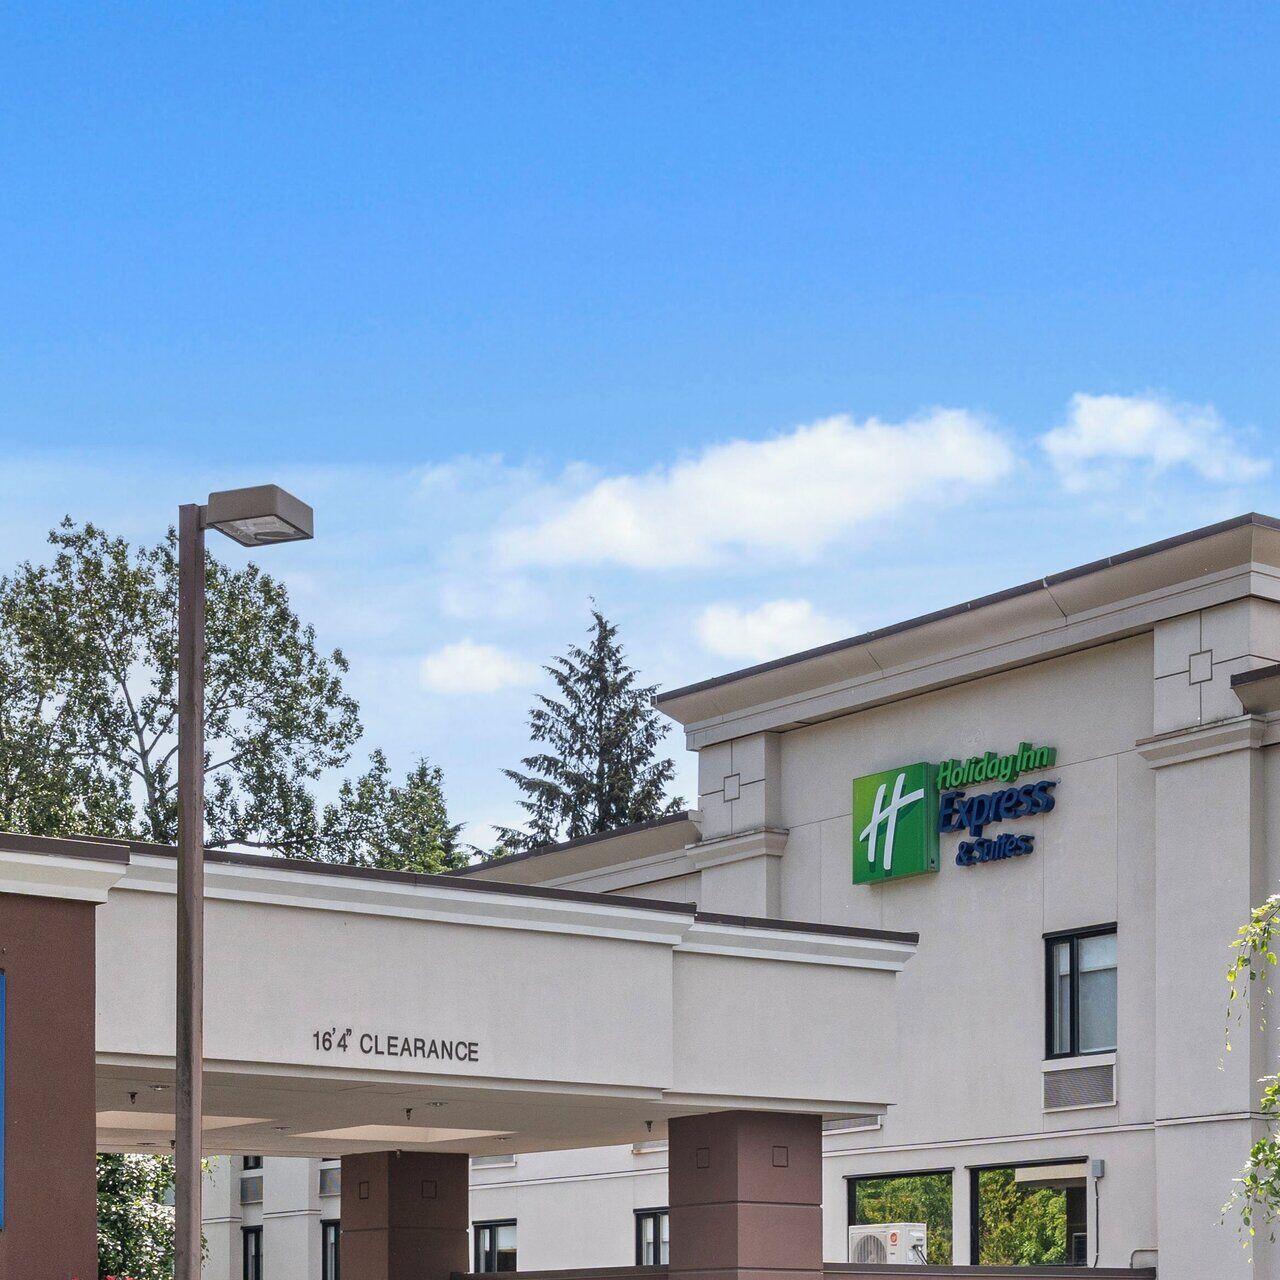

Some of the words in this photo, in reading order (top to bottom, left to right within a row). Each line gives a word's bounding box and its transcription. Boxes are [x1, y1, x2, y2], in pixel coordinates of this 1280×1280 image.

[937, 751, 1019, 790] Holiday
[1017, 742, 1056, 772] Inn
[939, 781, 1056, 837] Express
[956, 841, 977, 866] &
[974, 833, 1035, 863] Suites
[360, 1033, 479, 1062] CLEARANCE
